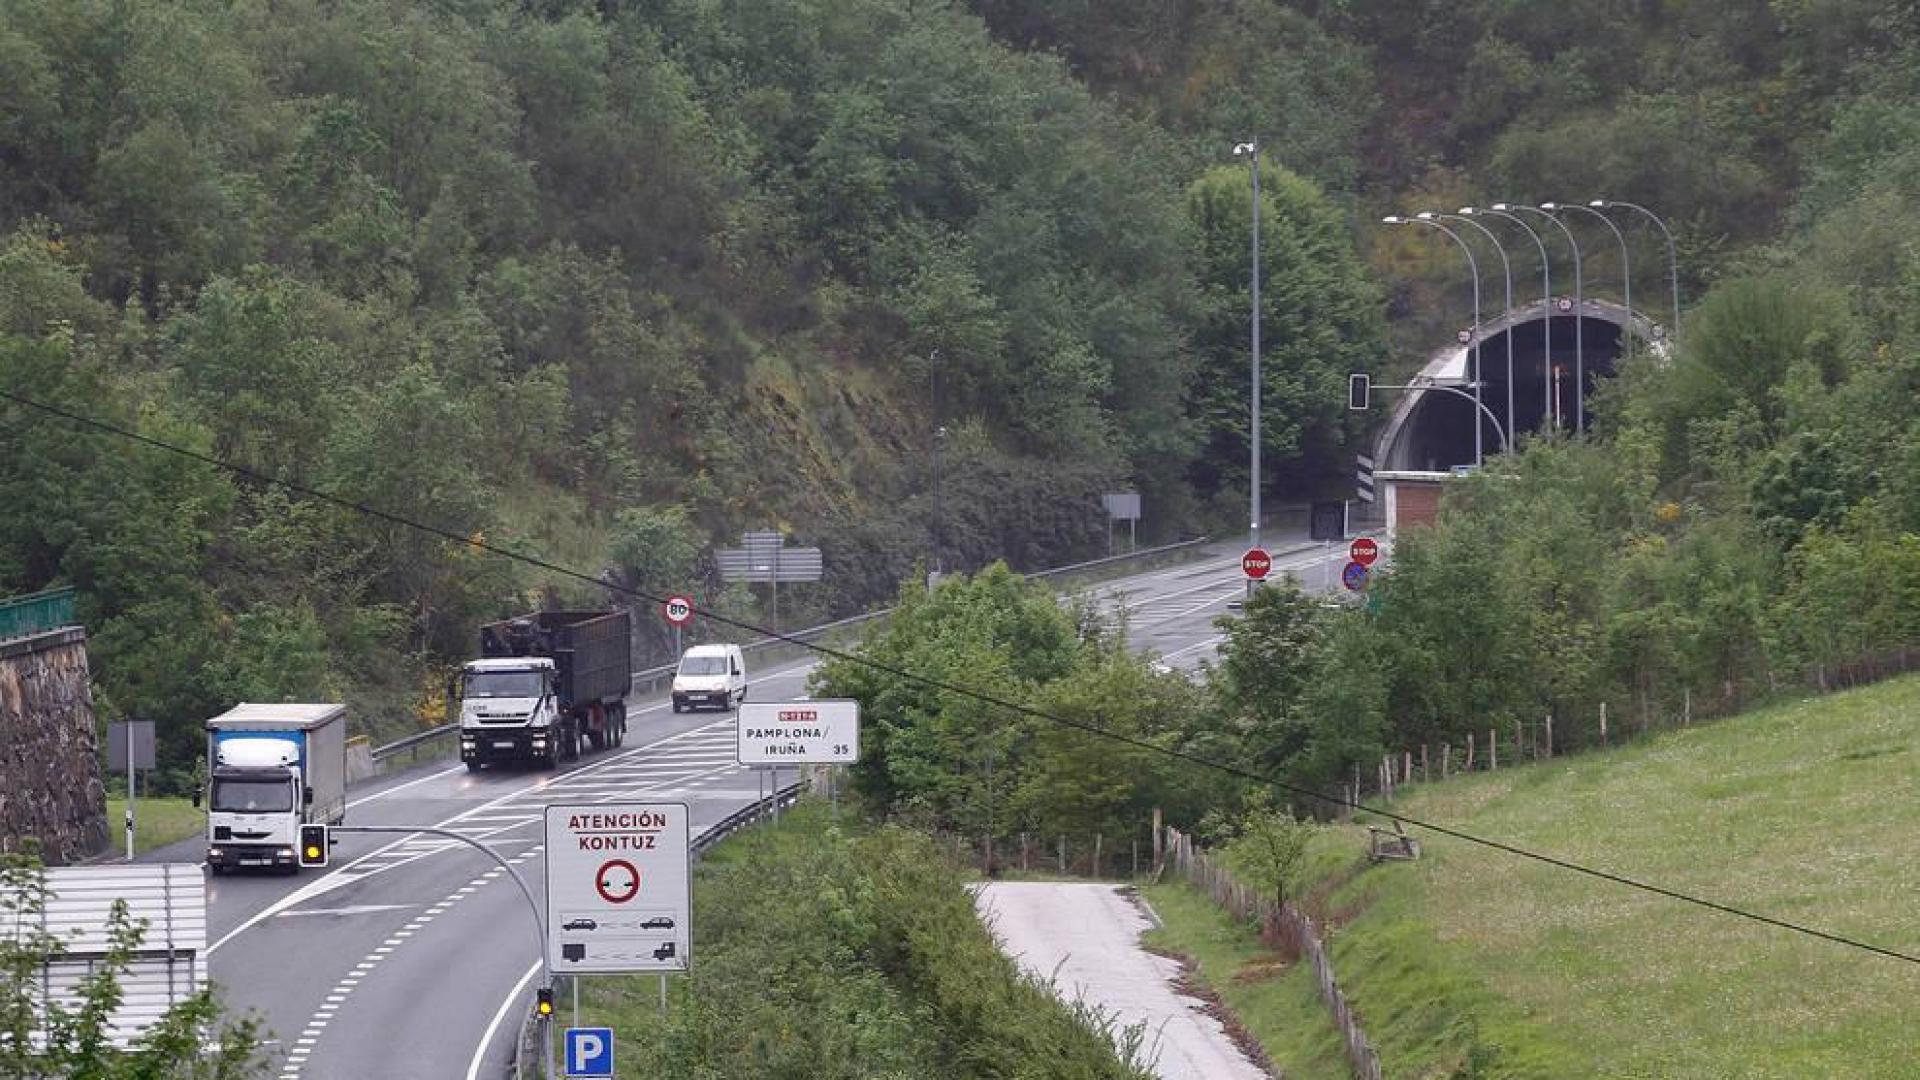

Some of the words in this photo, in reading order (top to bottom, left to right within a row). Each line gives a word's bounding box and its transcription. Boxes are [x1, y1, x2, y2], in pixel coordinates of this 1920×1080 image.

[1244, 560, 1269, 569] STOP
[670, 604, 688, 615] 80
[746, 725, 830, 739] PAMPLONA/
[765, 742, 806, 755] IRUÑA
[833, 744, 849, 755] 35
[568, 810, 666, 828] ATENCIÓN
[579, 836, 656, 850] KONTUZ
[575, 1034, 604, 1071] P
